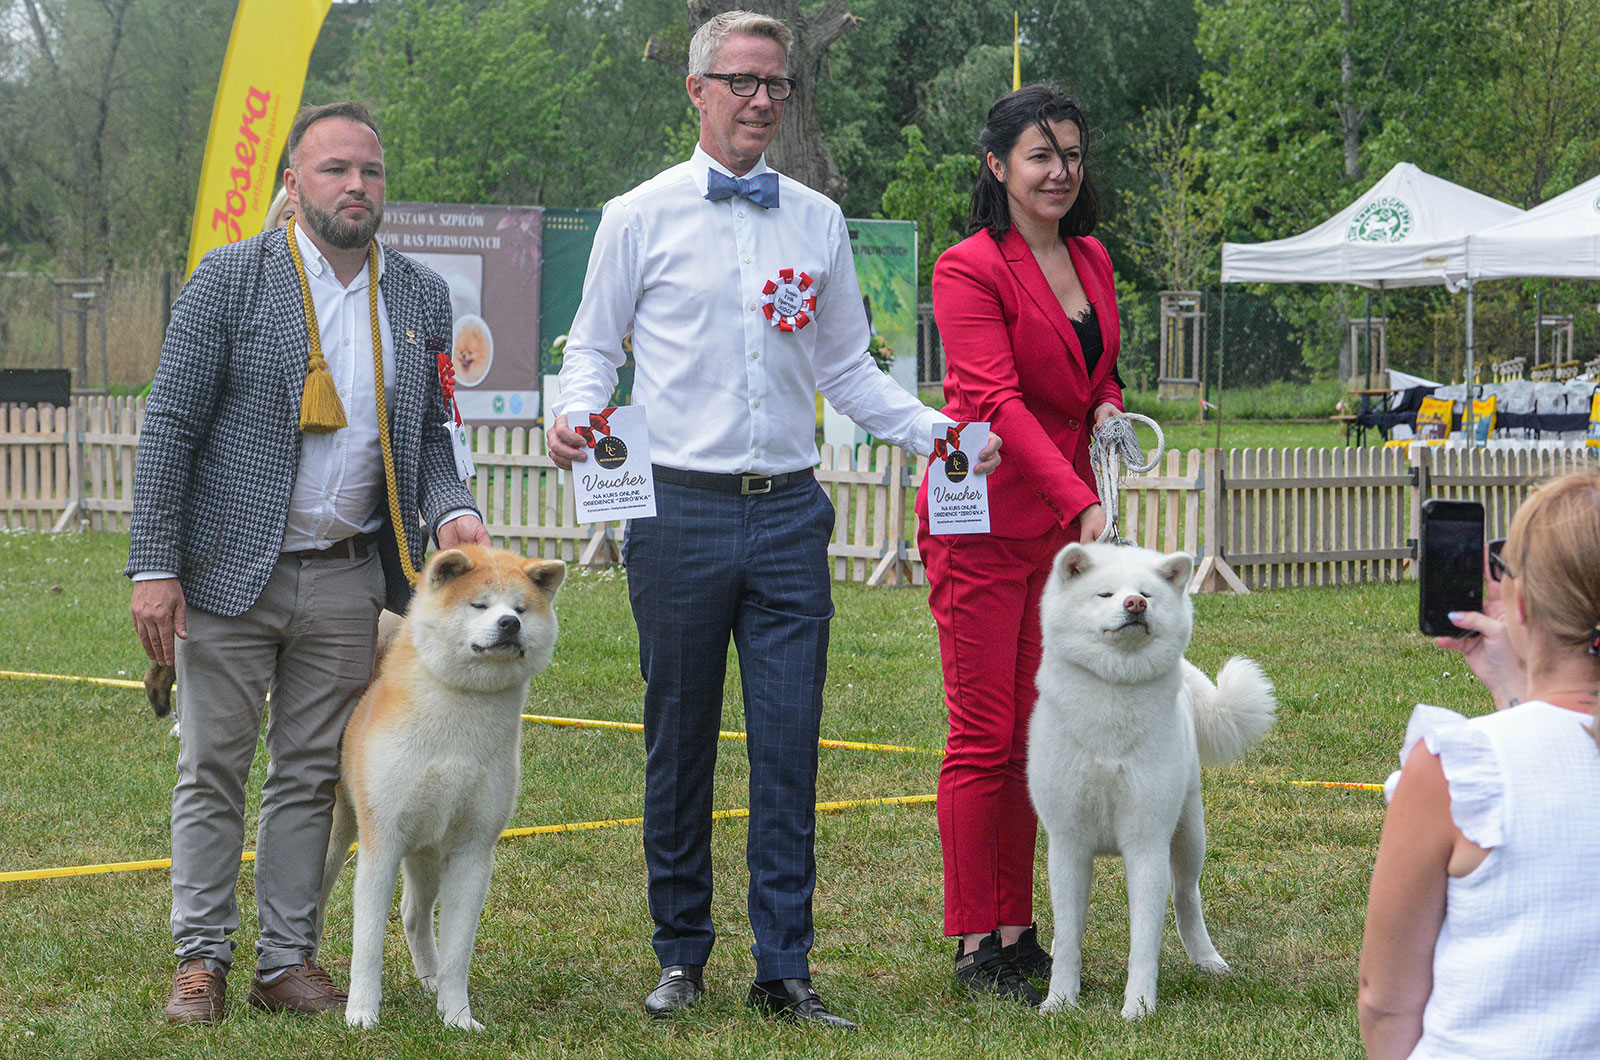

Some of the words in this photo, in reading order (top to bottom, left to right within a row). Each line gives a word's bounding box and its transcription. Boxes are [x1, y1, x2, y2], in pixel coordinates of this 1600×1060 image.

[212, 85, 271, 243] Josera
[439, 212, 484, 228] SZPICÓW
[403, 233, 425, 247] RAS
[426, 234, 501, 250] PIERWOTNYCH
[582, 471, 647, 491] Voucher
[933, 485, 983, 503] Voucher
